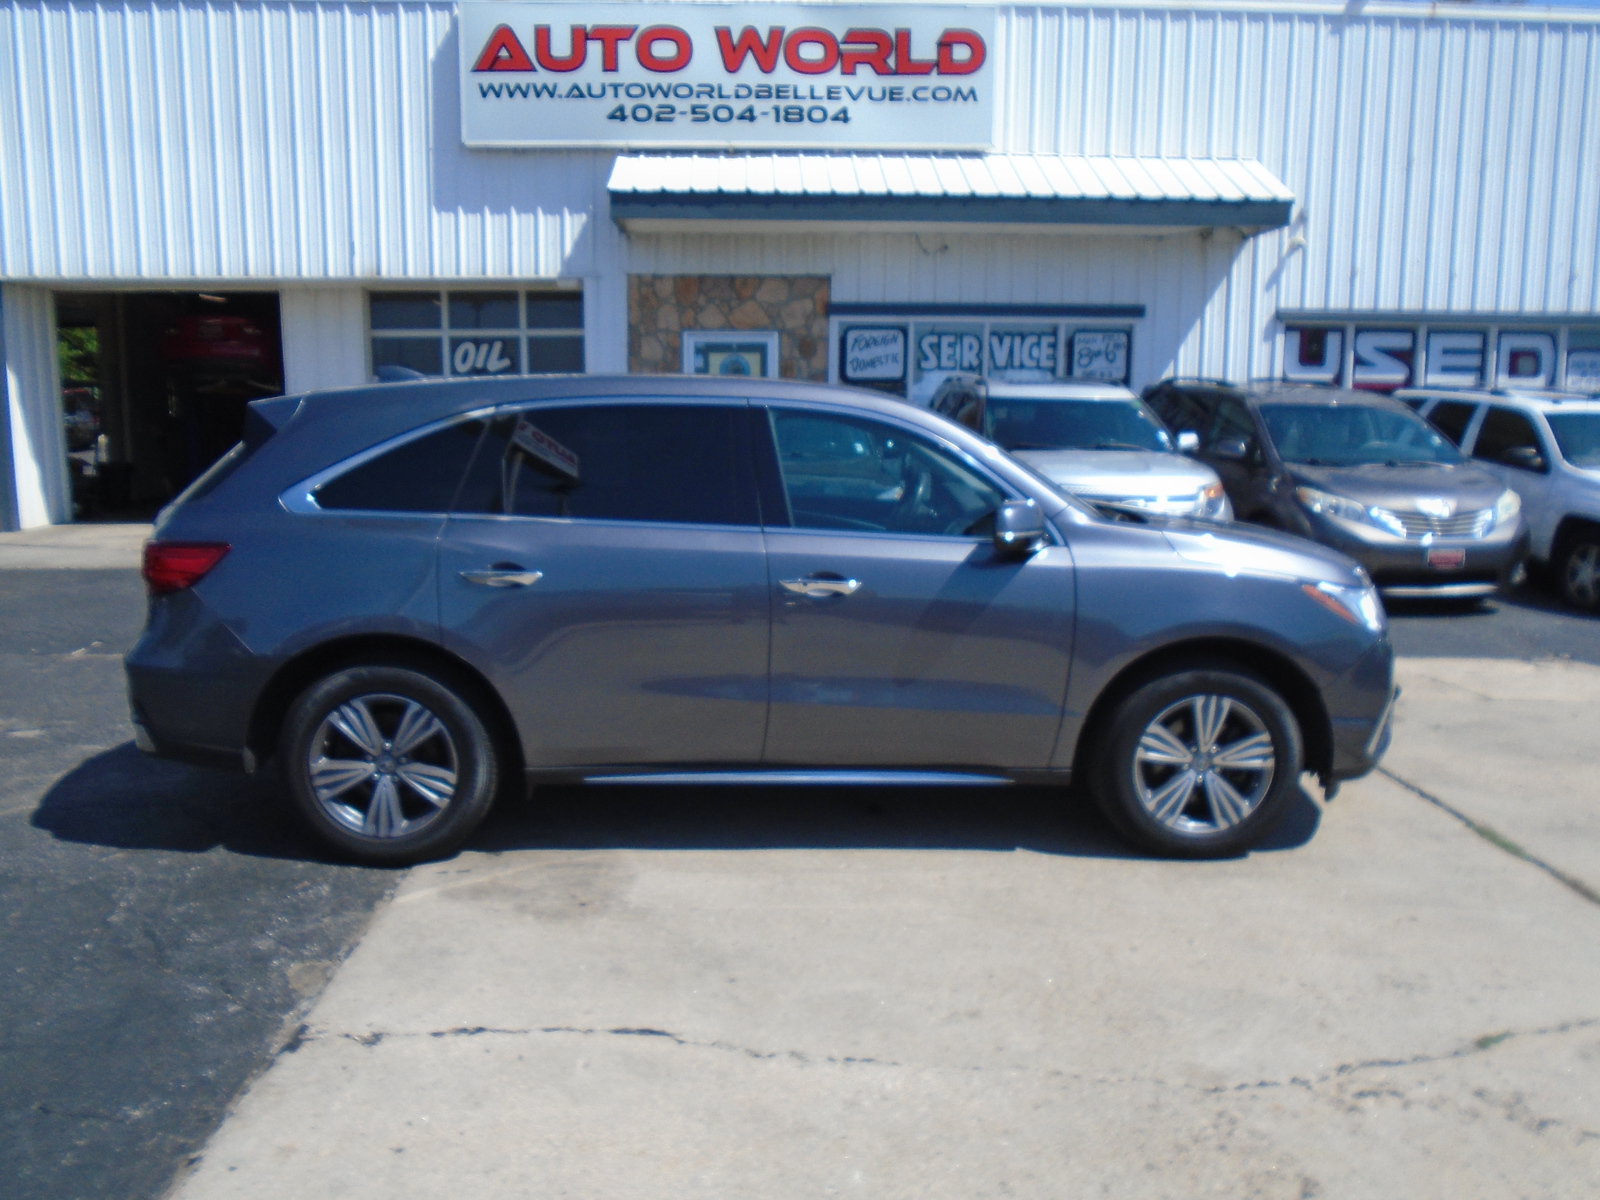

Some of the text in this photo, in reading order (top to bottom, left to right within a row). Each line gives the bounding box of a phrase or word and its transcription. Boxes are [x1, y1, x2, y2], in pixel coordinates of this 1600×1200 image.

[470, 23, 987, 75] AUTO WORLD
[478, 82, 978, 101] WWW.AUTOWORLDBELLEVUE.COM
[606, 104, 851, 123] 402-504-1804
[454, 341, 511, 373] OIL
[919, 332, 1056, 370] SERVICE
[1283, 330, 1556, 386] USED
